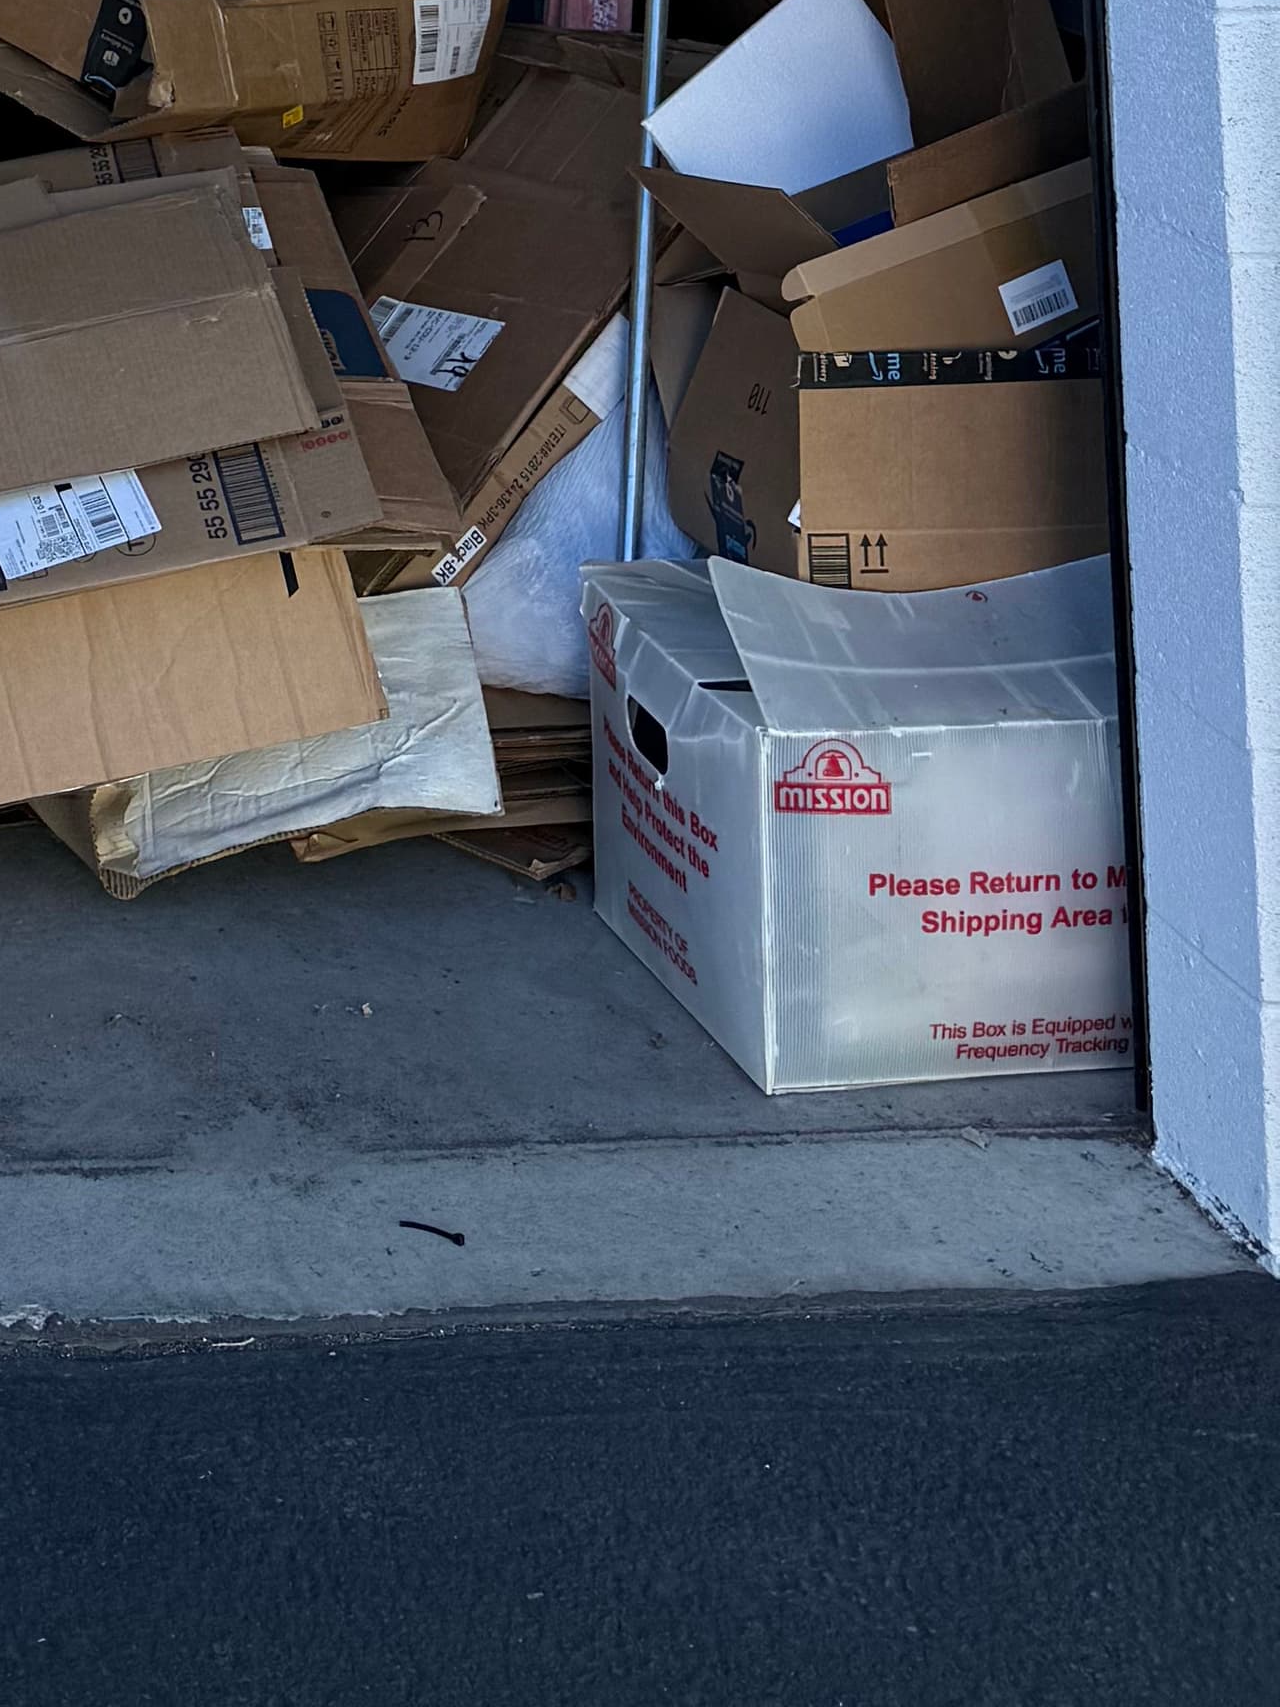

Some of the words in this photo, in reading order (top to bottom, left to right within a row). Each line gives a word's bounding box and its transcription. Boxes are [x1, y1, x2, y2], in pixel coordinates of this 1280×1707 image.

[197, 488, 220, 511] 55
[205, 516, 228, 539] 55
[603, 715, 627, 767] Please
[627, 747, 661, 798] Return
[662, 790, 686, 827] this
[689, 811, 719, 853] Box
[622, 777, 642, 819] Help
[643, 798, 686, 859] Protect
[687, 844, 710, 879] the
[621, 802, 688, 894] Environment
[868, 872, 961, 897] Please
[969, 869, 1062, 895] Return
[1071, 867, 1098, 889] to
[628, 879, 674, 945] PROPERTY
[673, 928, 689, 955] OF
[921, 909, 1043, 937] Shipping
[1050, 905, 1113, 929] Area
[660, 934, 698, 987] FOODS
[930, 1022, 967, 1040] This
[974, 1020, 1007, 1038] Box
[1012, 1017, 1027, 1036] is
[1031, 1014, 1116, 1040] Equipped
[956, 1040, 1050, 1061] Frequency
[1055, 1034, 1130, 1055] Tracking
